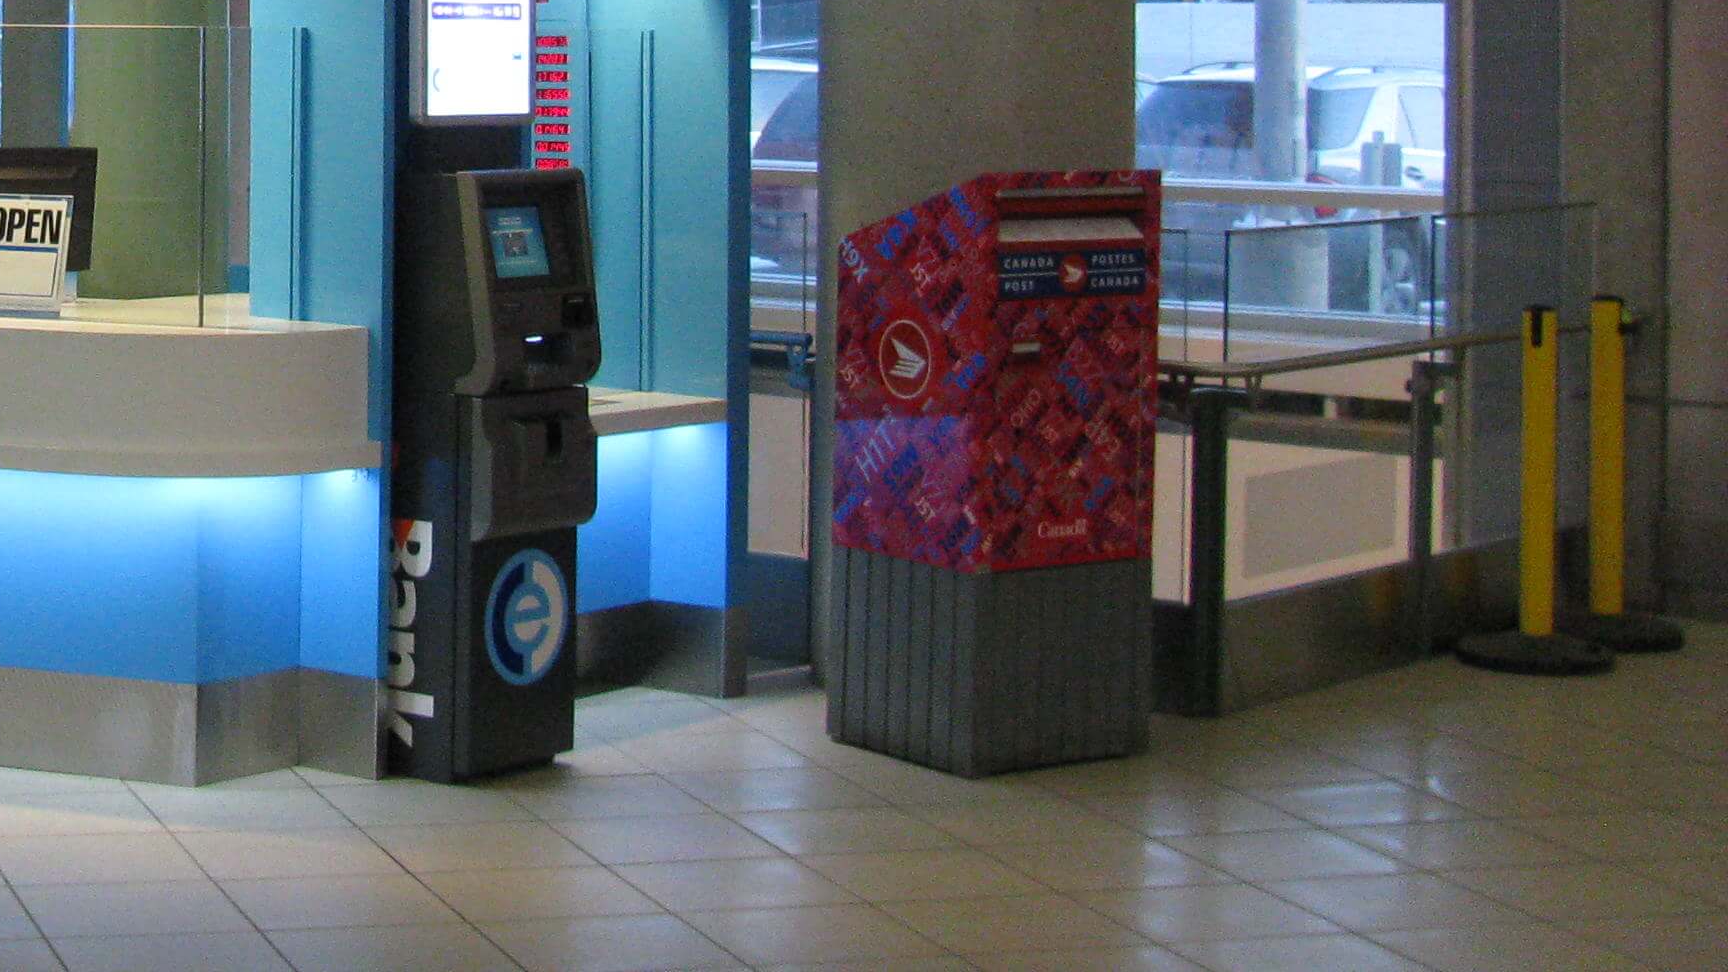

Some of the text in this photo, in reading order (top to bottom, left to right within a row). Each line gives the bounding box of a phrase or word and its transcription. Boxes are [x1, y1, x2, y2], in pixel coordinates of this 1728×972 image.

[1003, 256, 1054, 270] CANADA
[1091, 253, 1135, 265] POSTES
[1004, 280, 1035, 292] POST
[1091, 276, 1140, 288] CANADA
[389, 519, 435, 750] Bank
